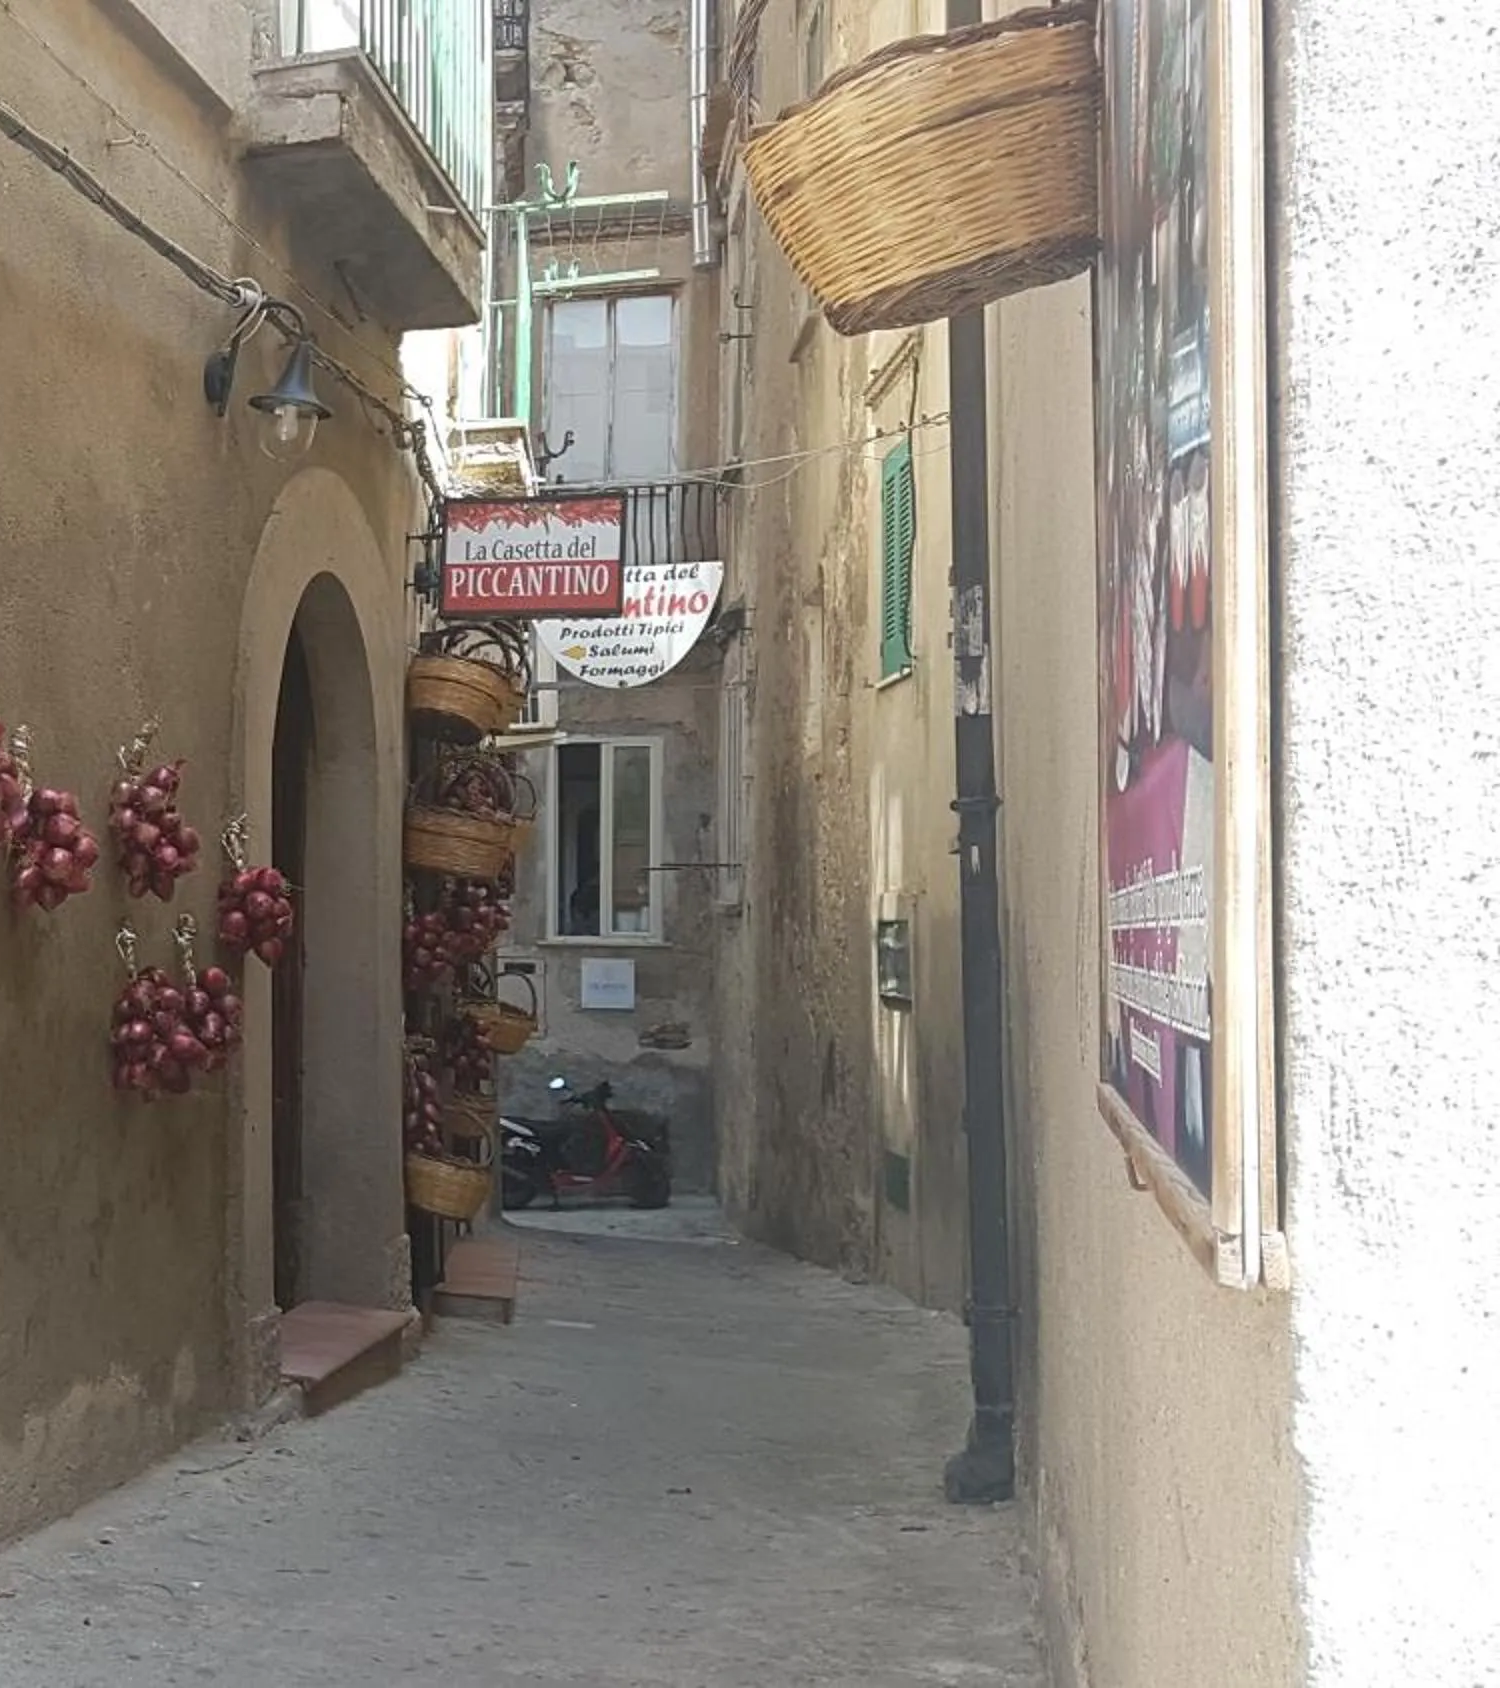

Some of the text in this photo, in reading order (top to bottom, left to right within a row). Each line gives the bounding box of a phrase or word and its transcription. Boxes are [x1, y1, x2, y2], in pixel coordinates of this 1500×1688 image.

[464, 535, 597, 562] La Casetta del
[450, 563, 610, 598] PICCANTINO
[624, 562, 700, 584] tta del
[623, 589, 711, 619] ntino
[559, 620, 685, 642] Prodotti Tipici
[588, 642, 655, 659] Salumi
[578, 662, 667, 679] Formaggi
